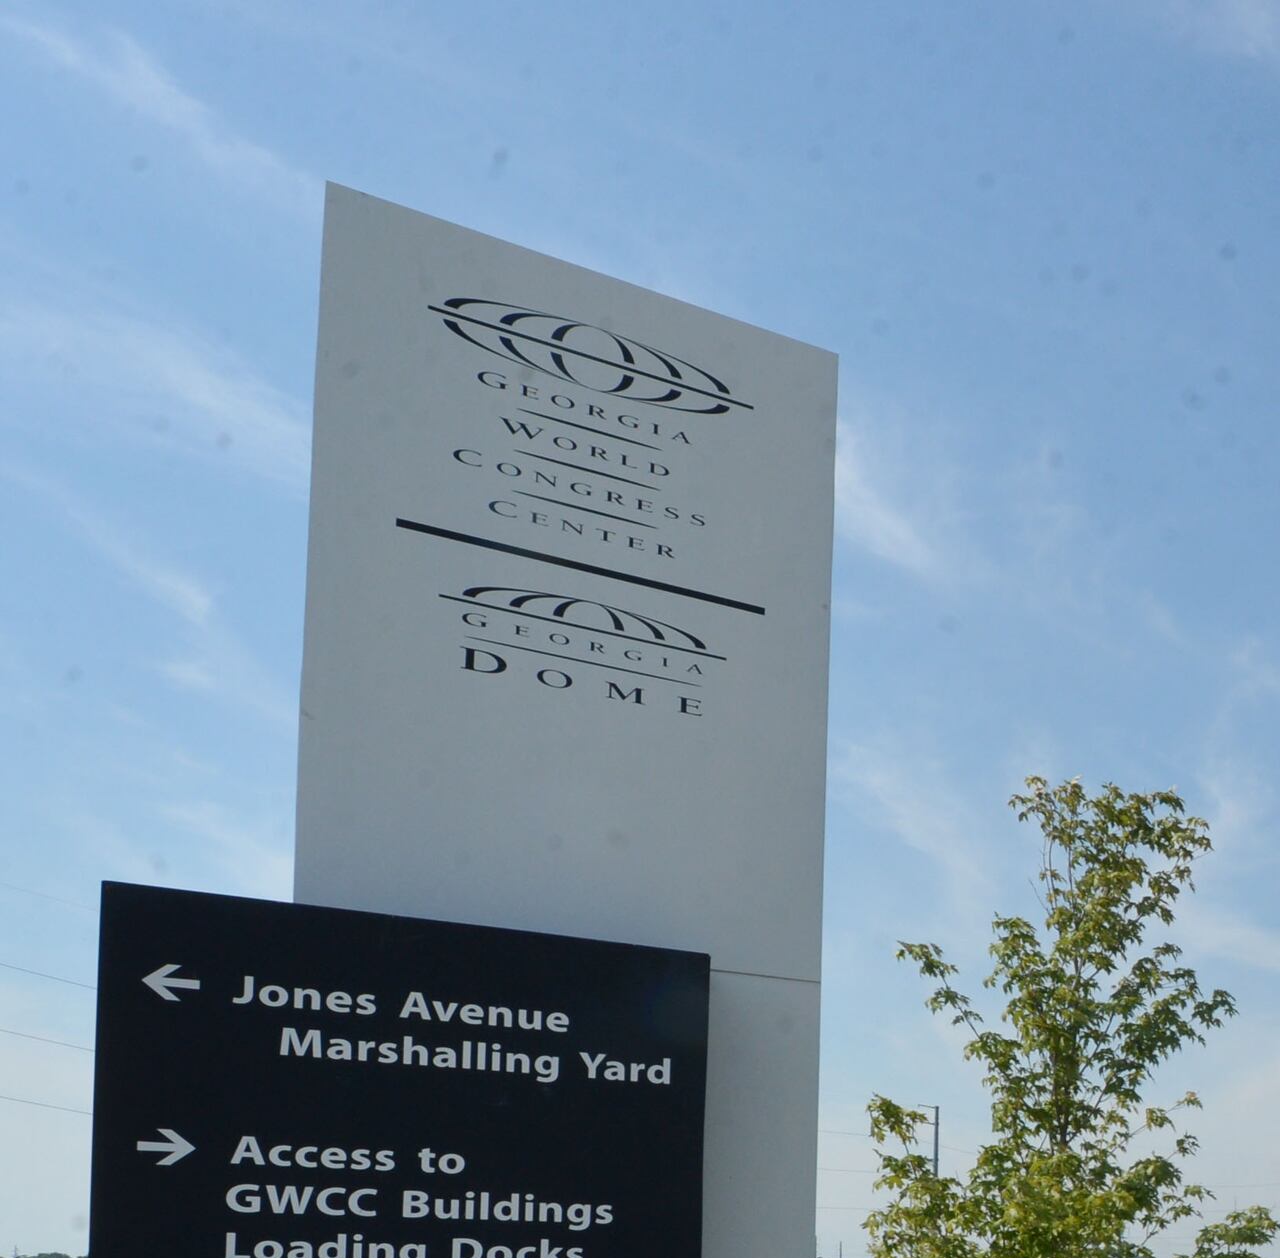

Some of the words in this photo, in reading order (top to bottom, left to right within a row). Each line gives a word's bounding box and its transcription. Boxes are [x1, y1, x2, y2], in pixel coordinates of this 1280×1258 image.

[477, 370, 692, 445] GEORGIA
[500, 417, 671, 478] WORLD
[452, 448, 707, 527] CONGRESS
[488, 500, 676, 559] CENTER
[461, 612, 703, 675] GEORGIA
[460, 646, 703, 716] DOME
[232, 975, 377, 1016] Jones
[399, 991, 571, 1034] Avenue
[279, 1027, 561, 1084] Marshalling
[579, 1051, 672, 1085] Yard
[230, 1135, 396, 1172] Access
[417, 1147, 466, 1175] to
[225, 1183, 379, 1217] GWCC
[402, 1190, 614, 1231] Buildings
